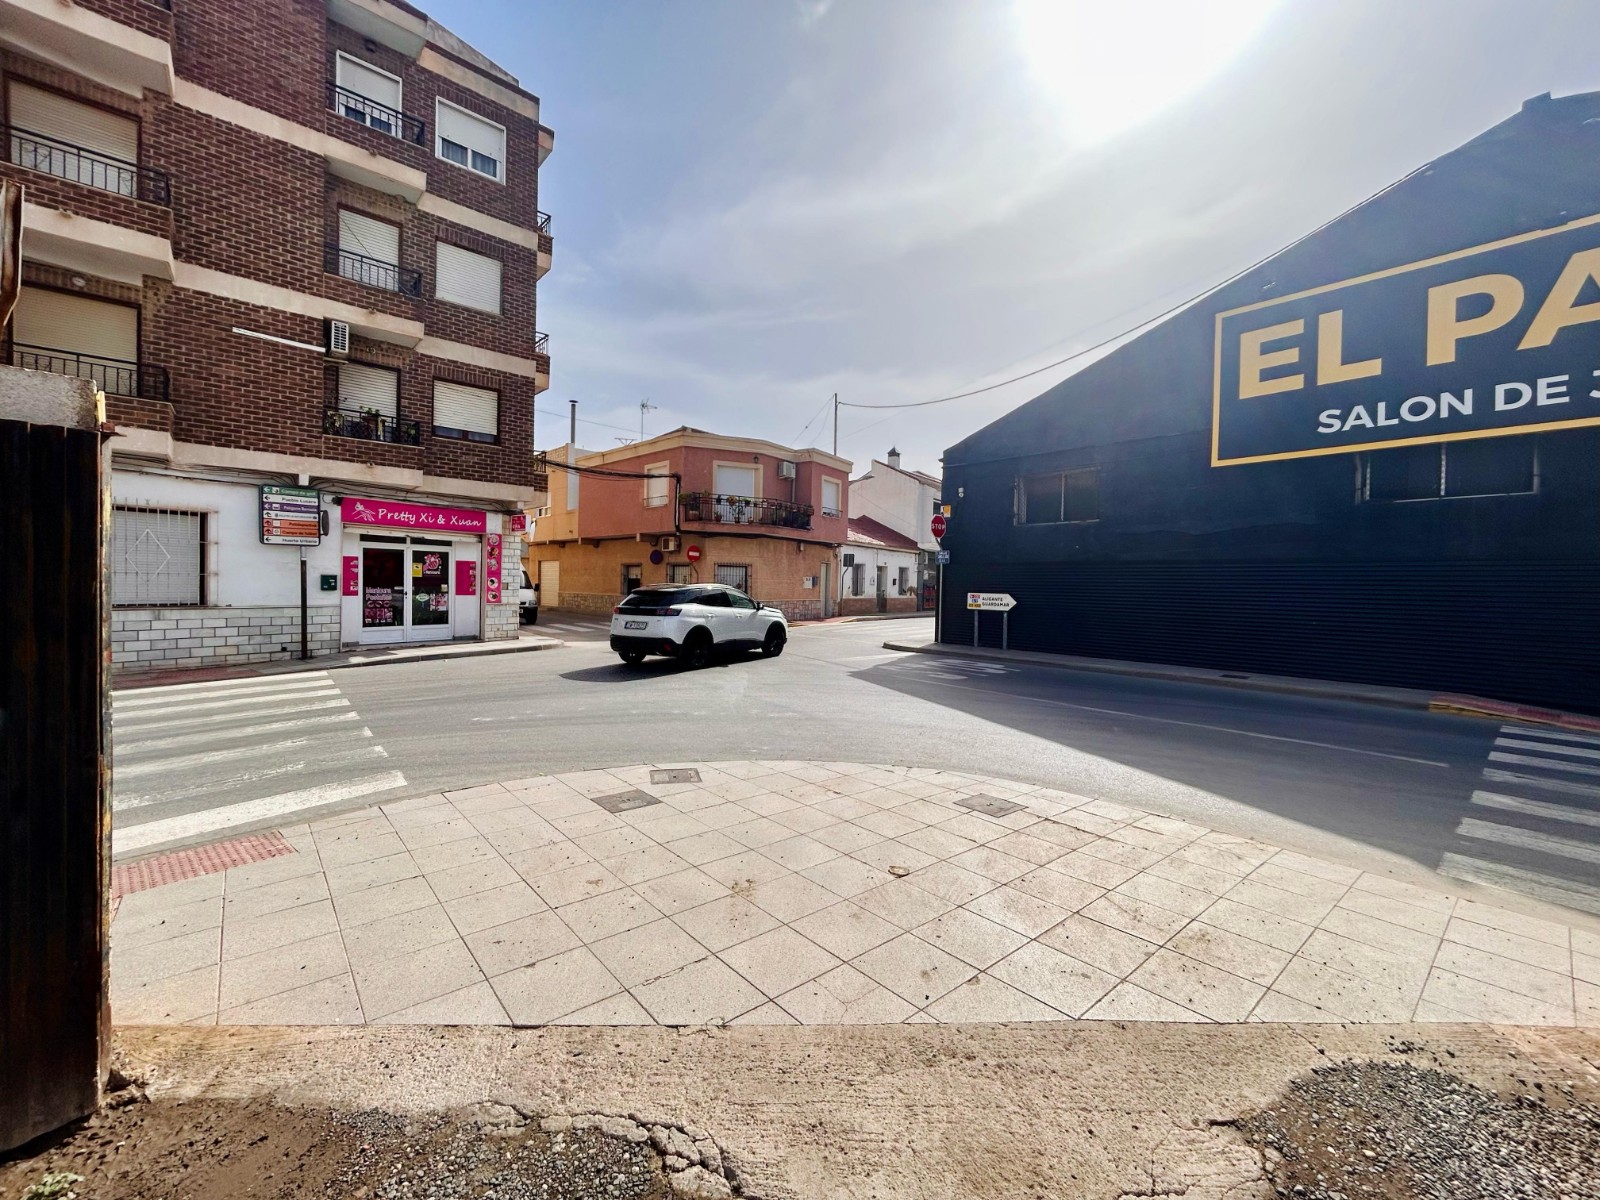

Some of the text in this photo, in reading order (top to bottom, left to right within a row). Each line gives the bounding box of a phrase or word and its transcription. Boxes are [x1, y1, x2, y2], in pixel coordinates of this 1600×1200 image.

[1239, 309, 1382, 399] EL
[1316, 388, 1473, 434] SALON
[1494, 374, 1570, 412] DE
[378, 508, 482, 527] Pretty Xi & Xuan
